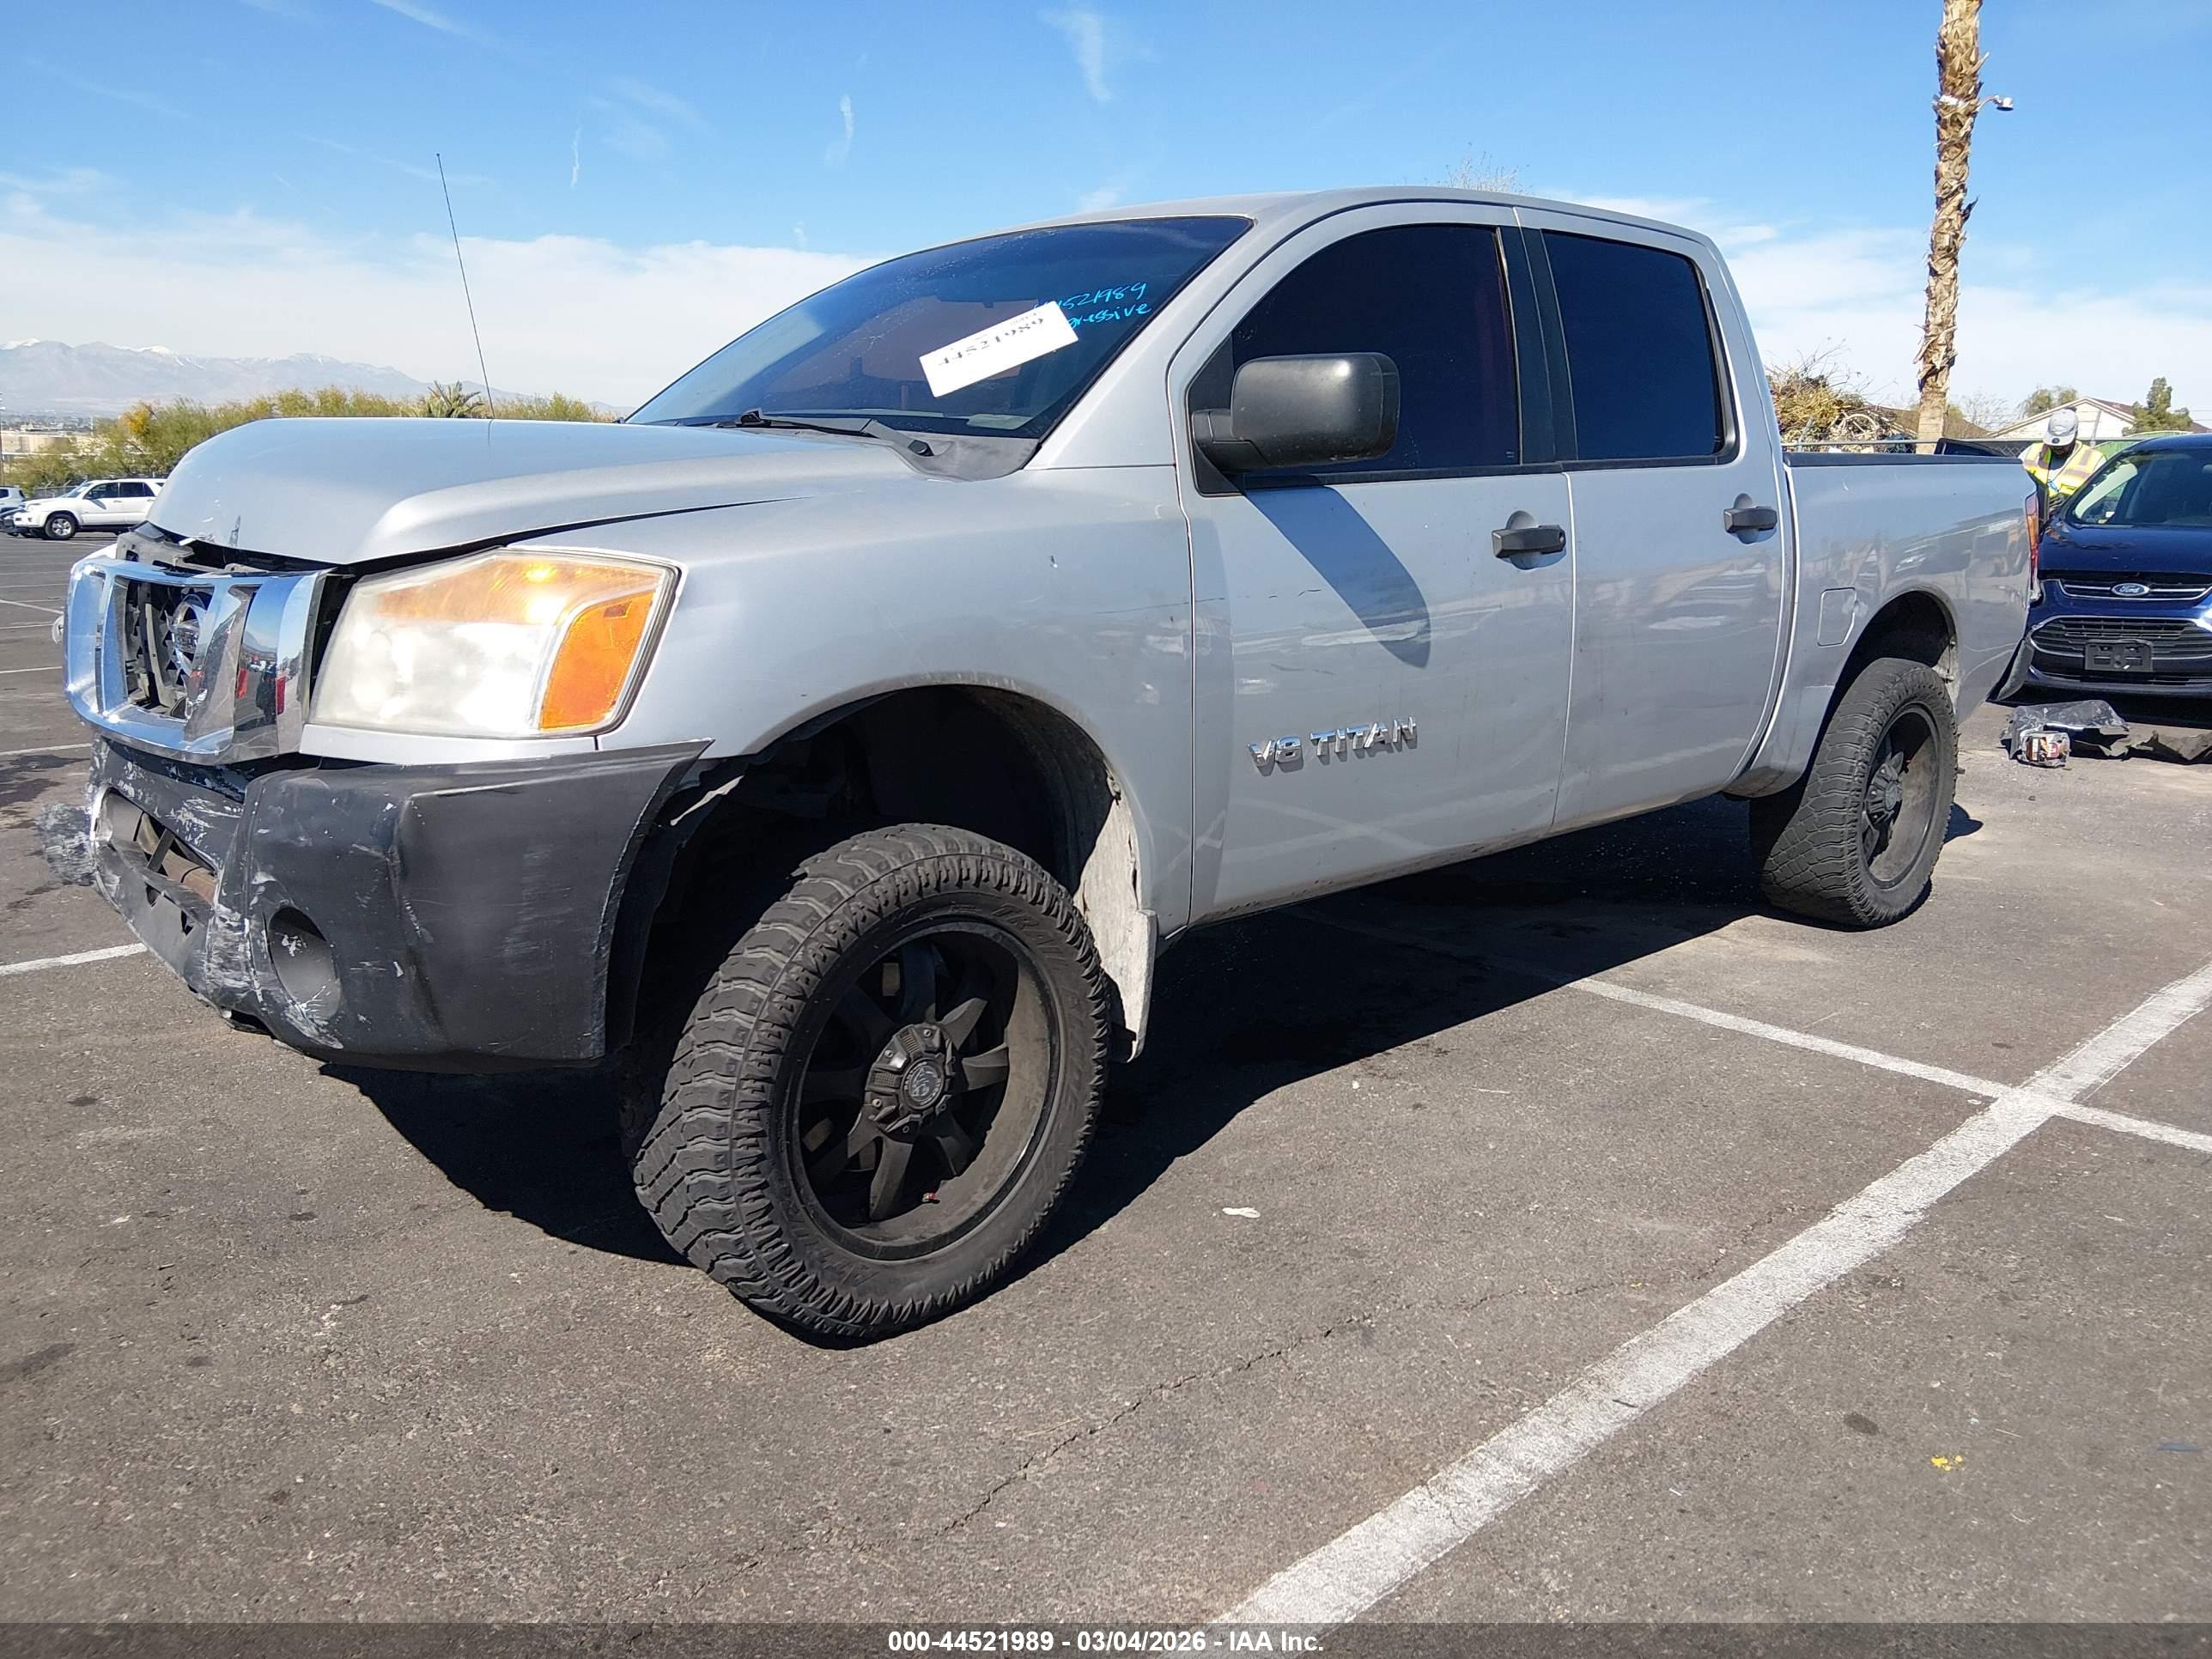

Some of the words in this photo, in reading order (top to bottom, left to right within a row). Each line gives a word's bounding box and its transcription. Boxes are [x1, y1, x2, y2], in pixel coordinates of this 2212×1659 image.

[1033, 282, 1147, 310] 521989
[1067, 302, 1152, 330] gressive
[1247, 735, 1303, 767] V8
[1309, 716, 1418, 757] TITAN
